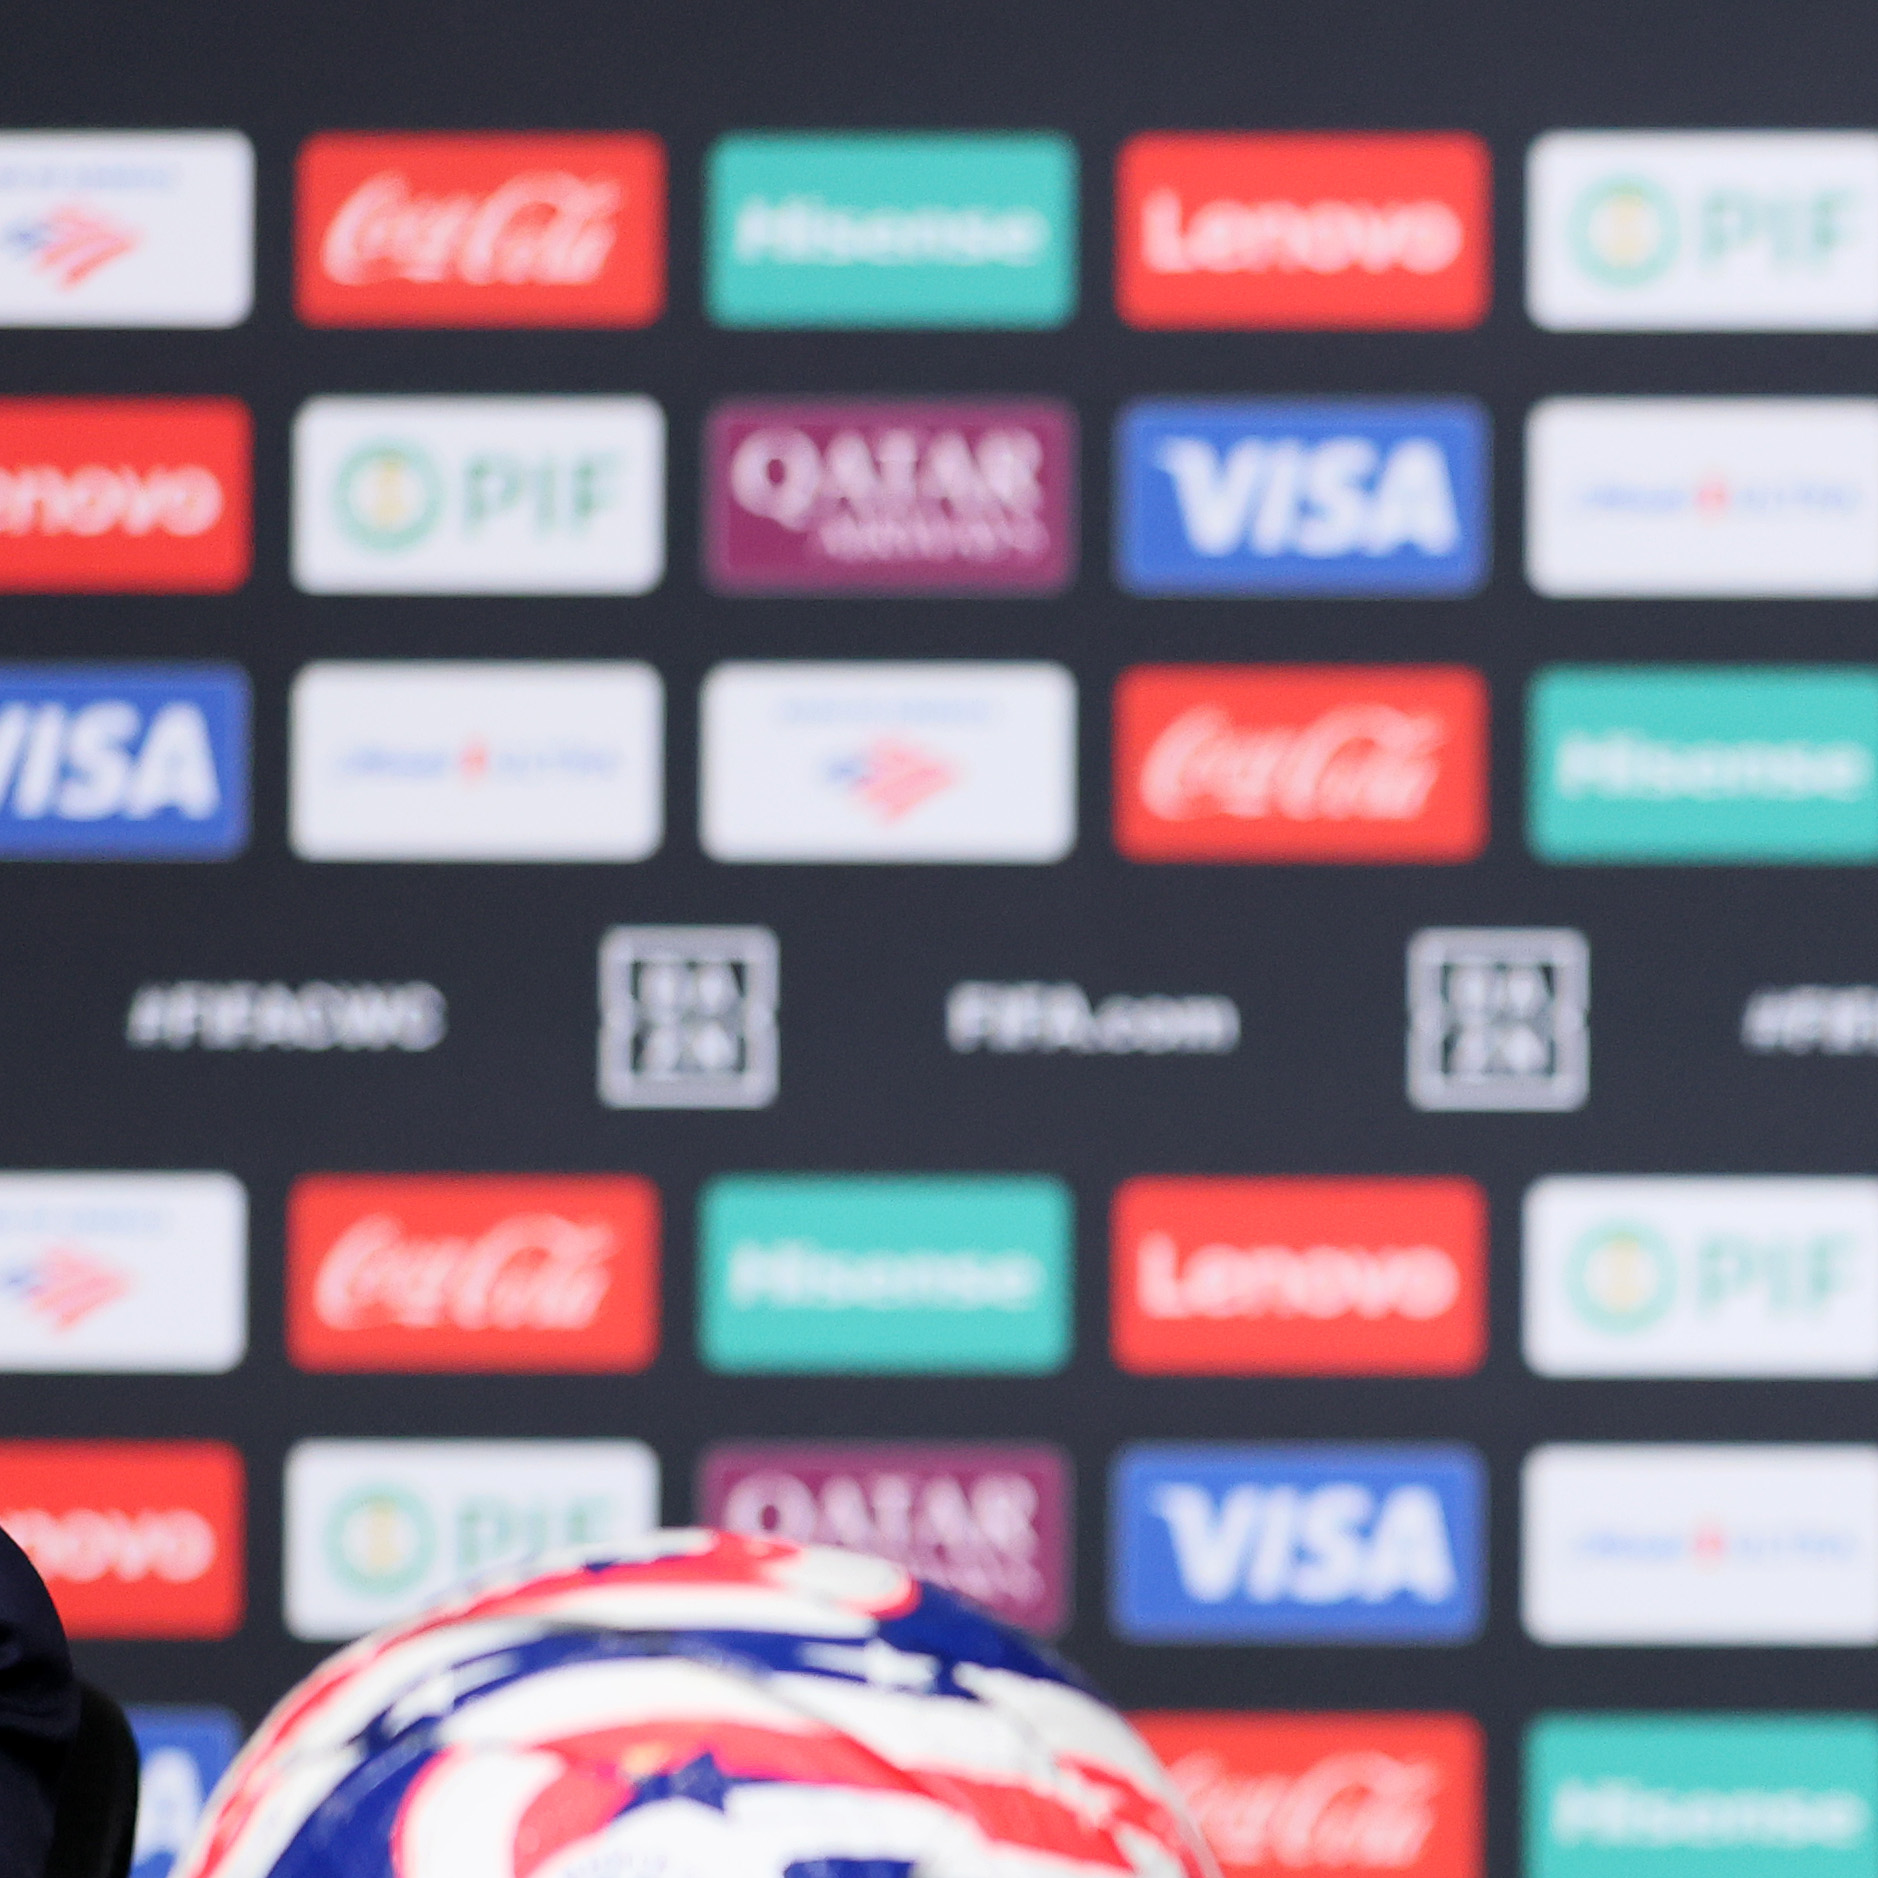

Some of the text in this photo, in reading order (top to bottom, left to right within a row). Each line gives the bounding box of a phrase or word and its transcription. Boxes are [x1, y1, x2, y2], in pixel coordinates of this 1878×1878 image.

[1142, 192, 1463, 273] Lenovo
[1694, 186, 1856, 268] PIF
[0, 464, 224, 537] novo
[460, 453, 616, 533] PIF
[731, 430, 1042, 532] QATAR
[1161, 437, 1459, 557] VISA
[1137, 1235, 1459, 1319] Lenovo
[1693, 1233, 1853, 1313] PIF
[1157, 1483, 1455, 1603] VISA
